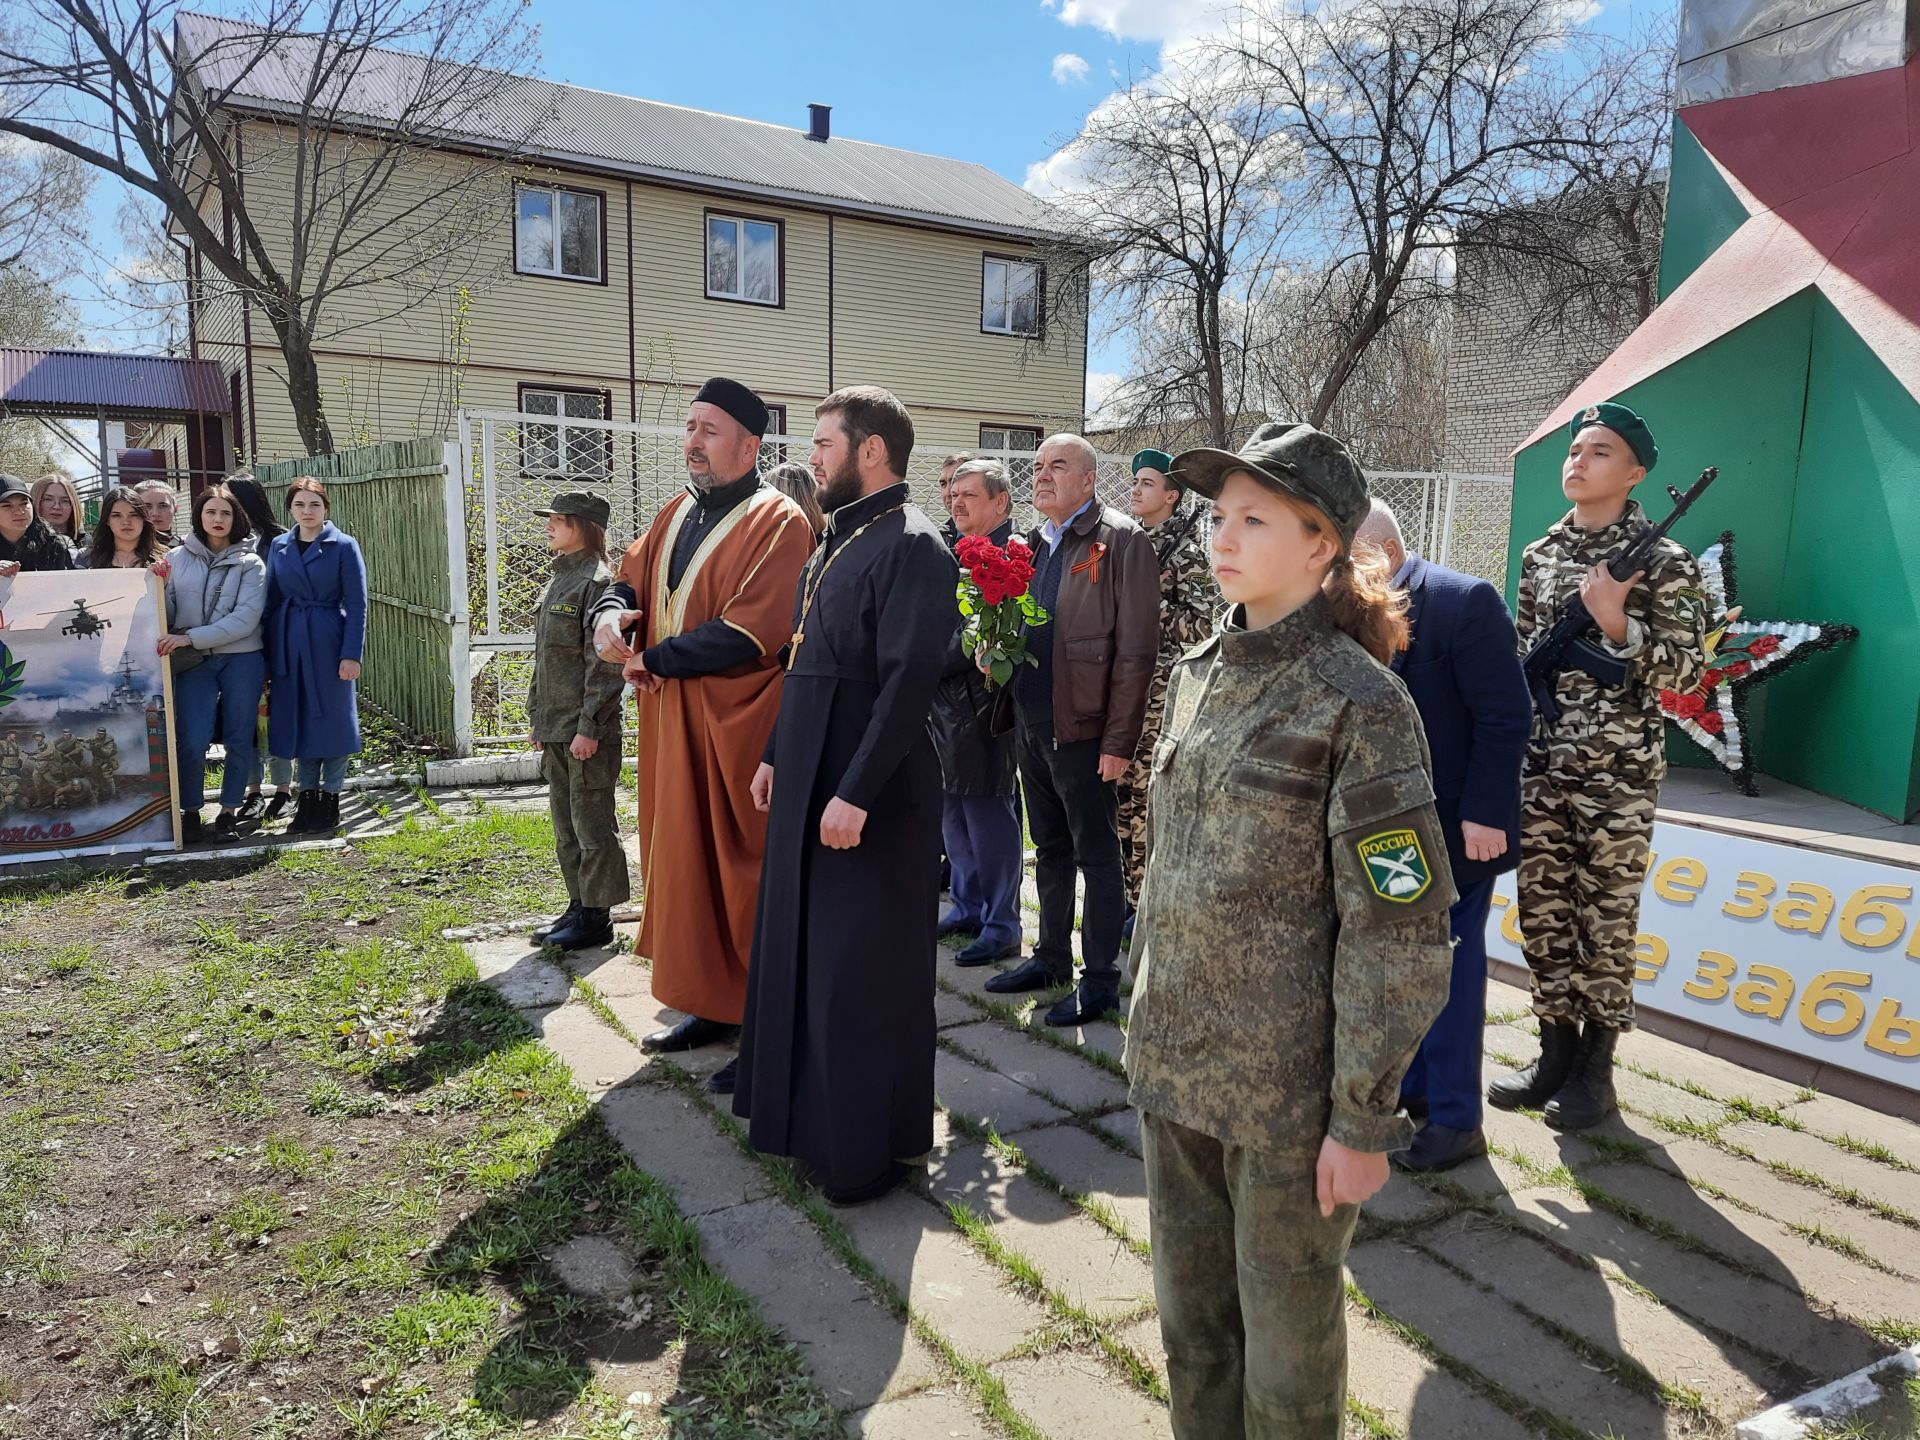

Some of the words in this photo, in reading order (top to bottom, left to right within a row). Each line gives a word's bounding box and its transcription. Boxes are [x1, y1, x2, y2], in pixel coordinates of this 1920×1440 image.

[1361, 833, 1416, 857] РОССИЯ
[1644, 851, 1708, 903] е
[1721, 870, 1920, 958] заб
